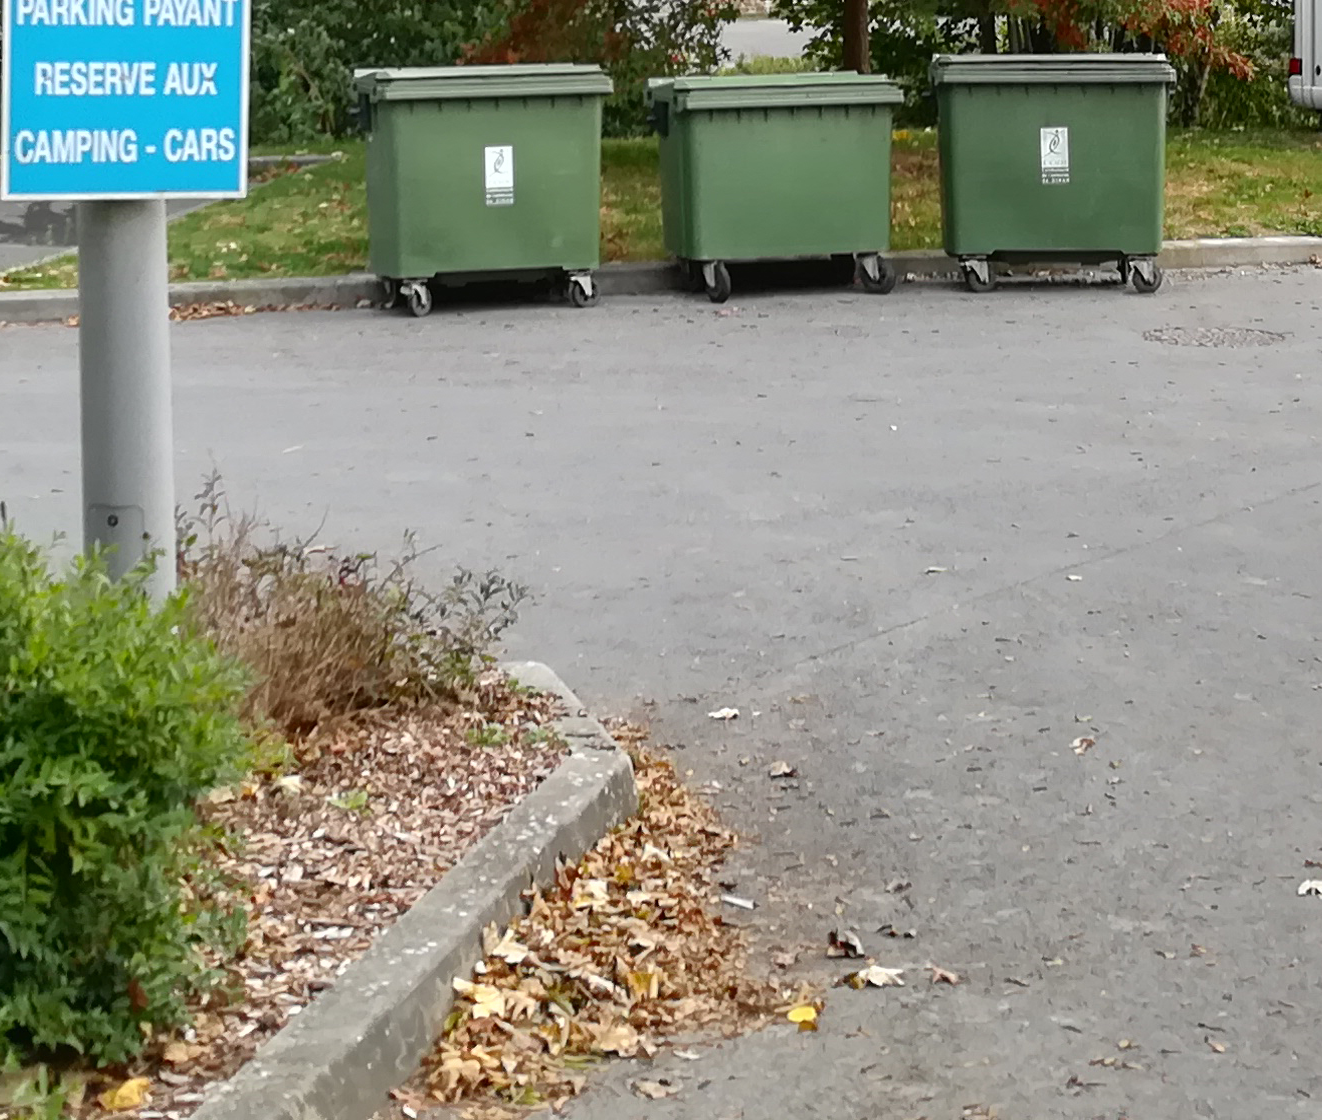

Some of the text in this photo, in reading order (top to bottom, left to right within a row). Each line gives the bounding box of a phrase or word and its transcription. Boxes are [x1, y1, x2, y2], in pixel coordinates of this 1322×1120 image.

[34, 61, 218, 96] RESERVE AUX
[14, 129, 138, 164] CAMPING
[163, 127, 236, 163] CARS
